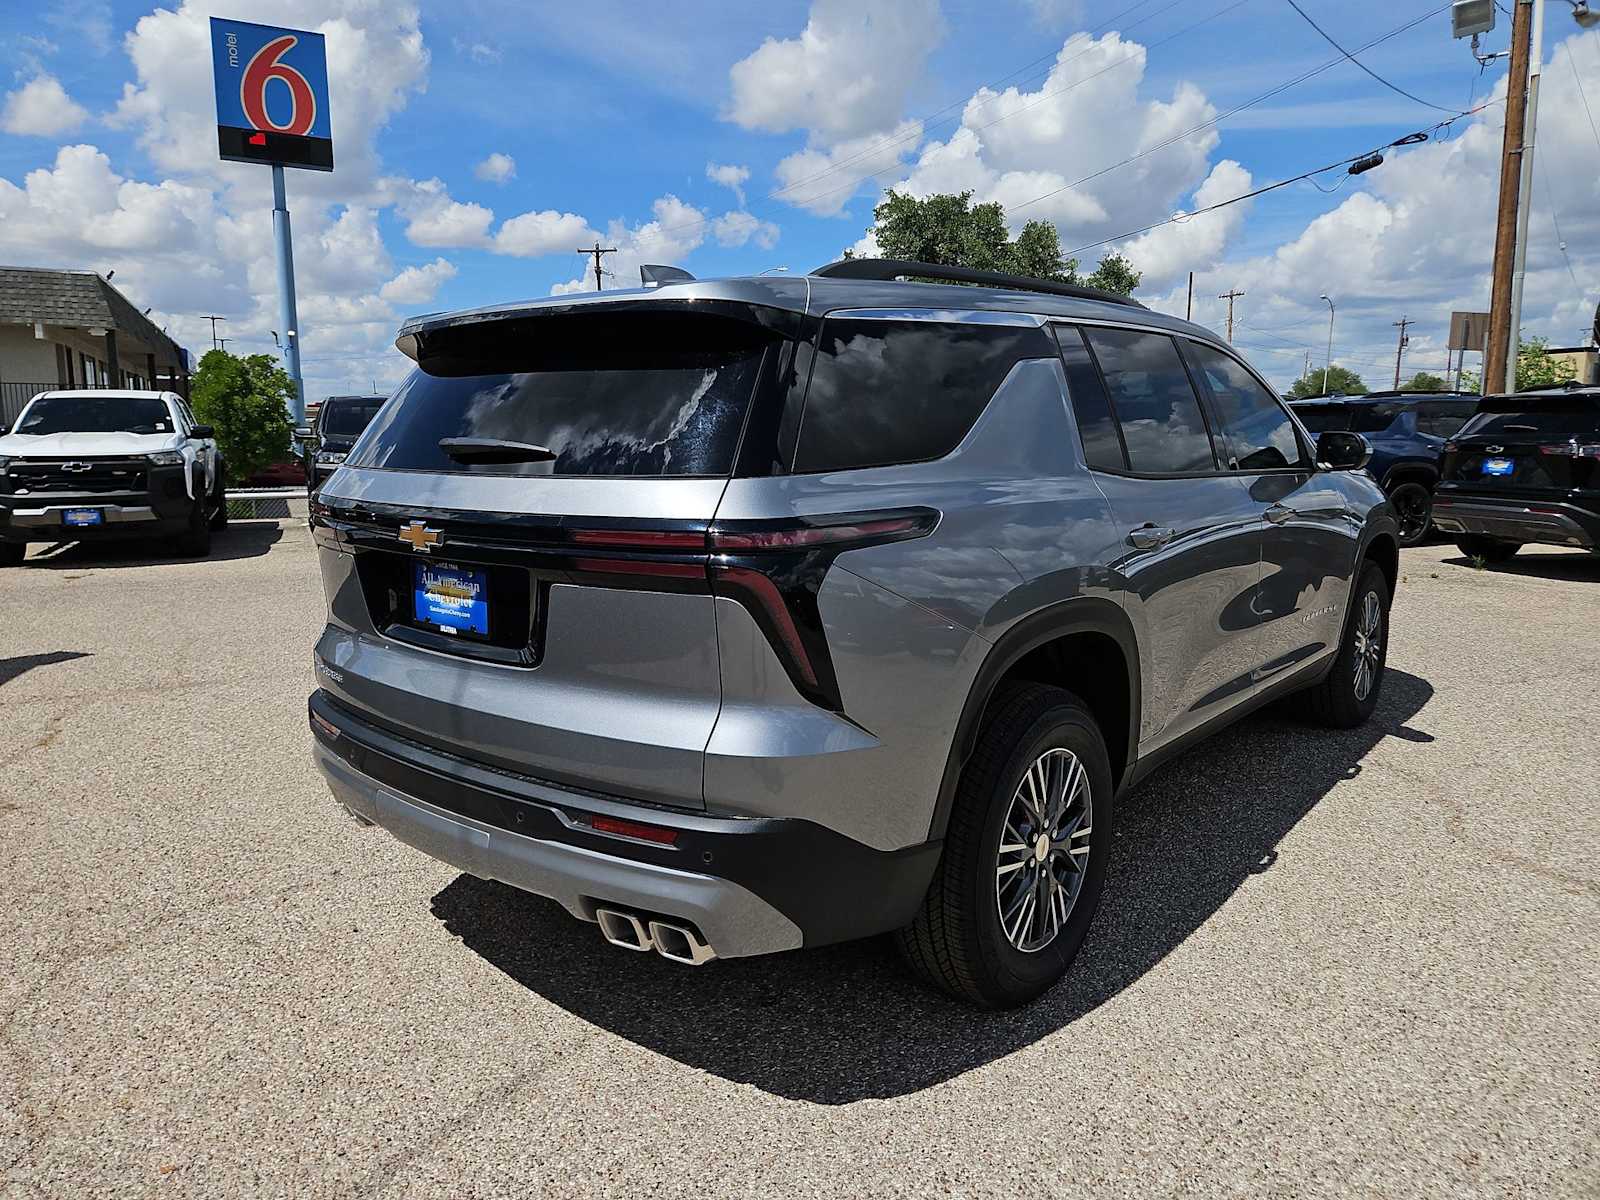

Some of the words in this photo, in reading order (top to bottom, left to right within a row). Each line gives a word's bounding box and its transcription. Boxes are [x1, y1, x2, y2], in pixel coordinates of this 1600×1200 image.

[225, 32, 239, 68] motel
[241, 35, 316, 136] 6
[422, 572, 433, 585] All
